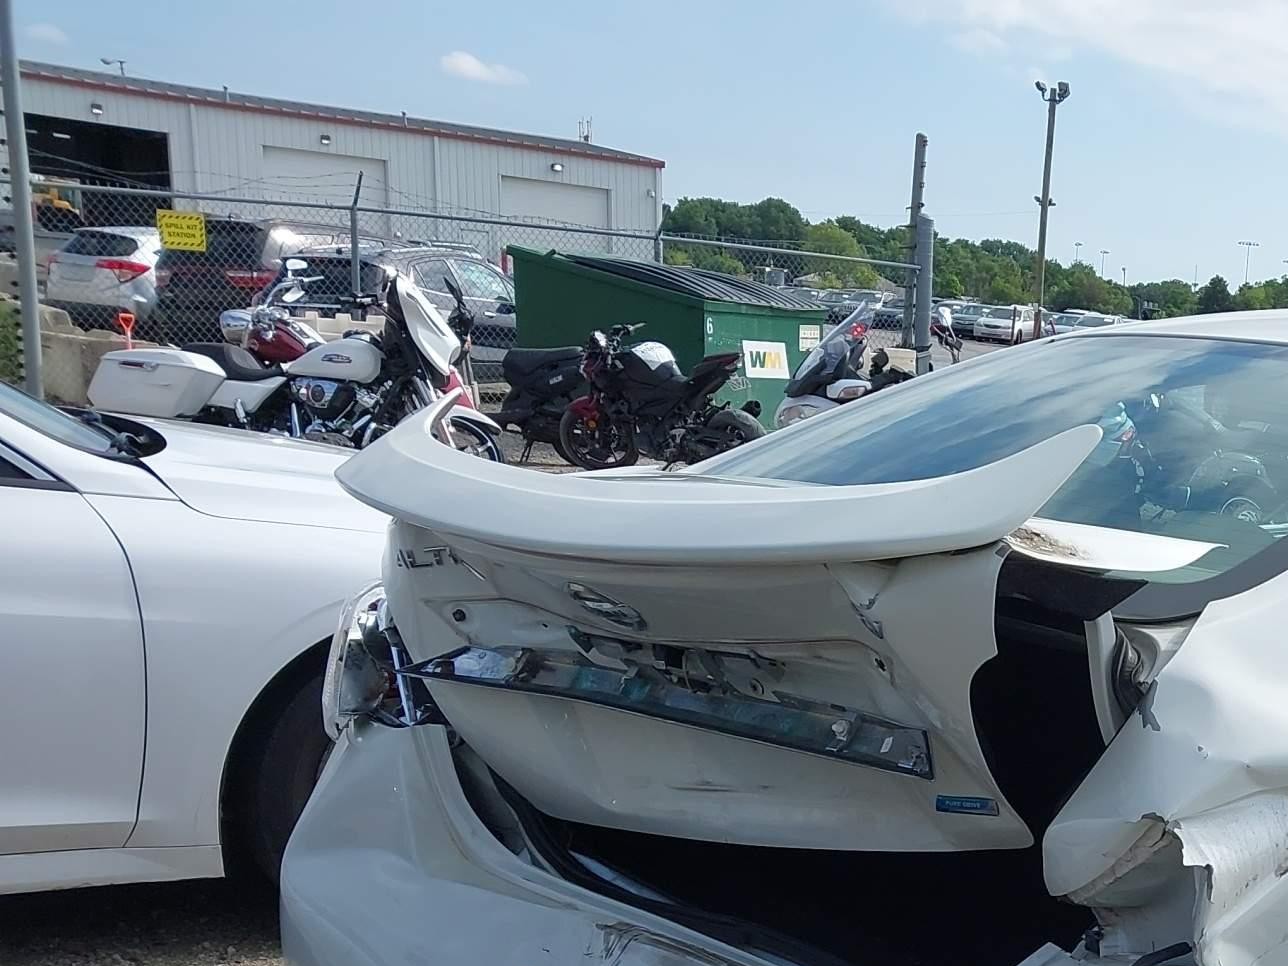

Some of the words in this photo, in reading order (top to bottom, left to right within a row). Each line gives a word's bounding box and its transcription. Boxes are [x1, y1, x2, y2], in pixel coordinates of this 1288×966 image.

[168, 231, 196, 239] STATION
[707, 317, 714, 334] 6
[749, 350, 781, 368] WM
